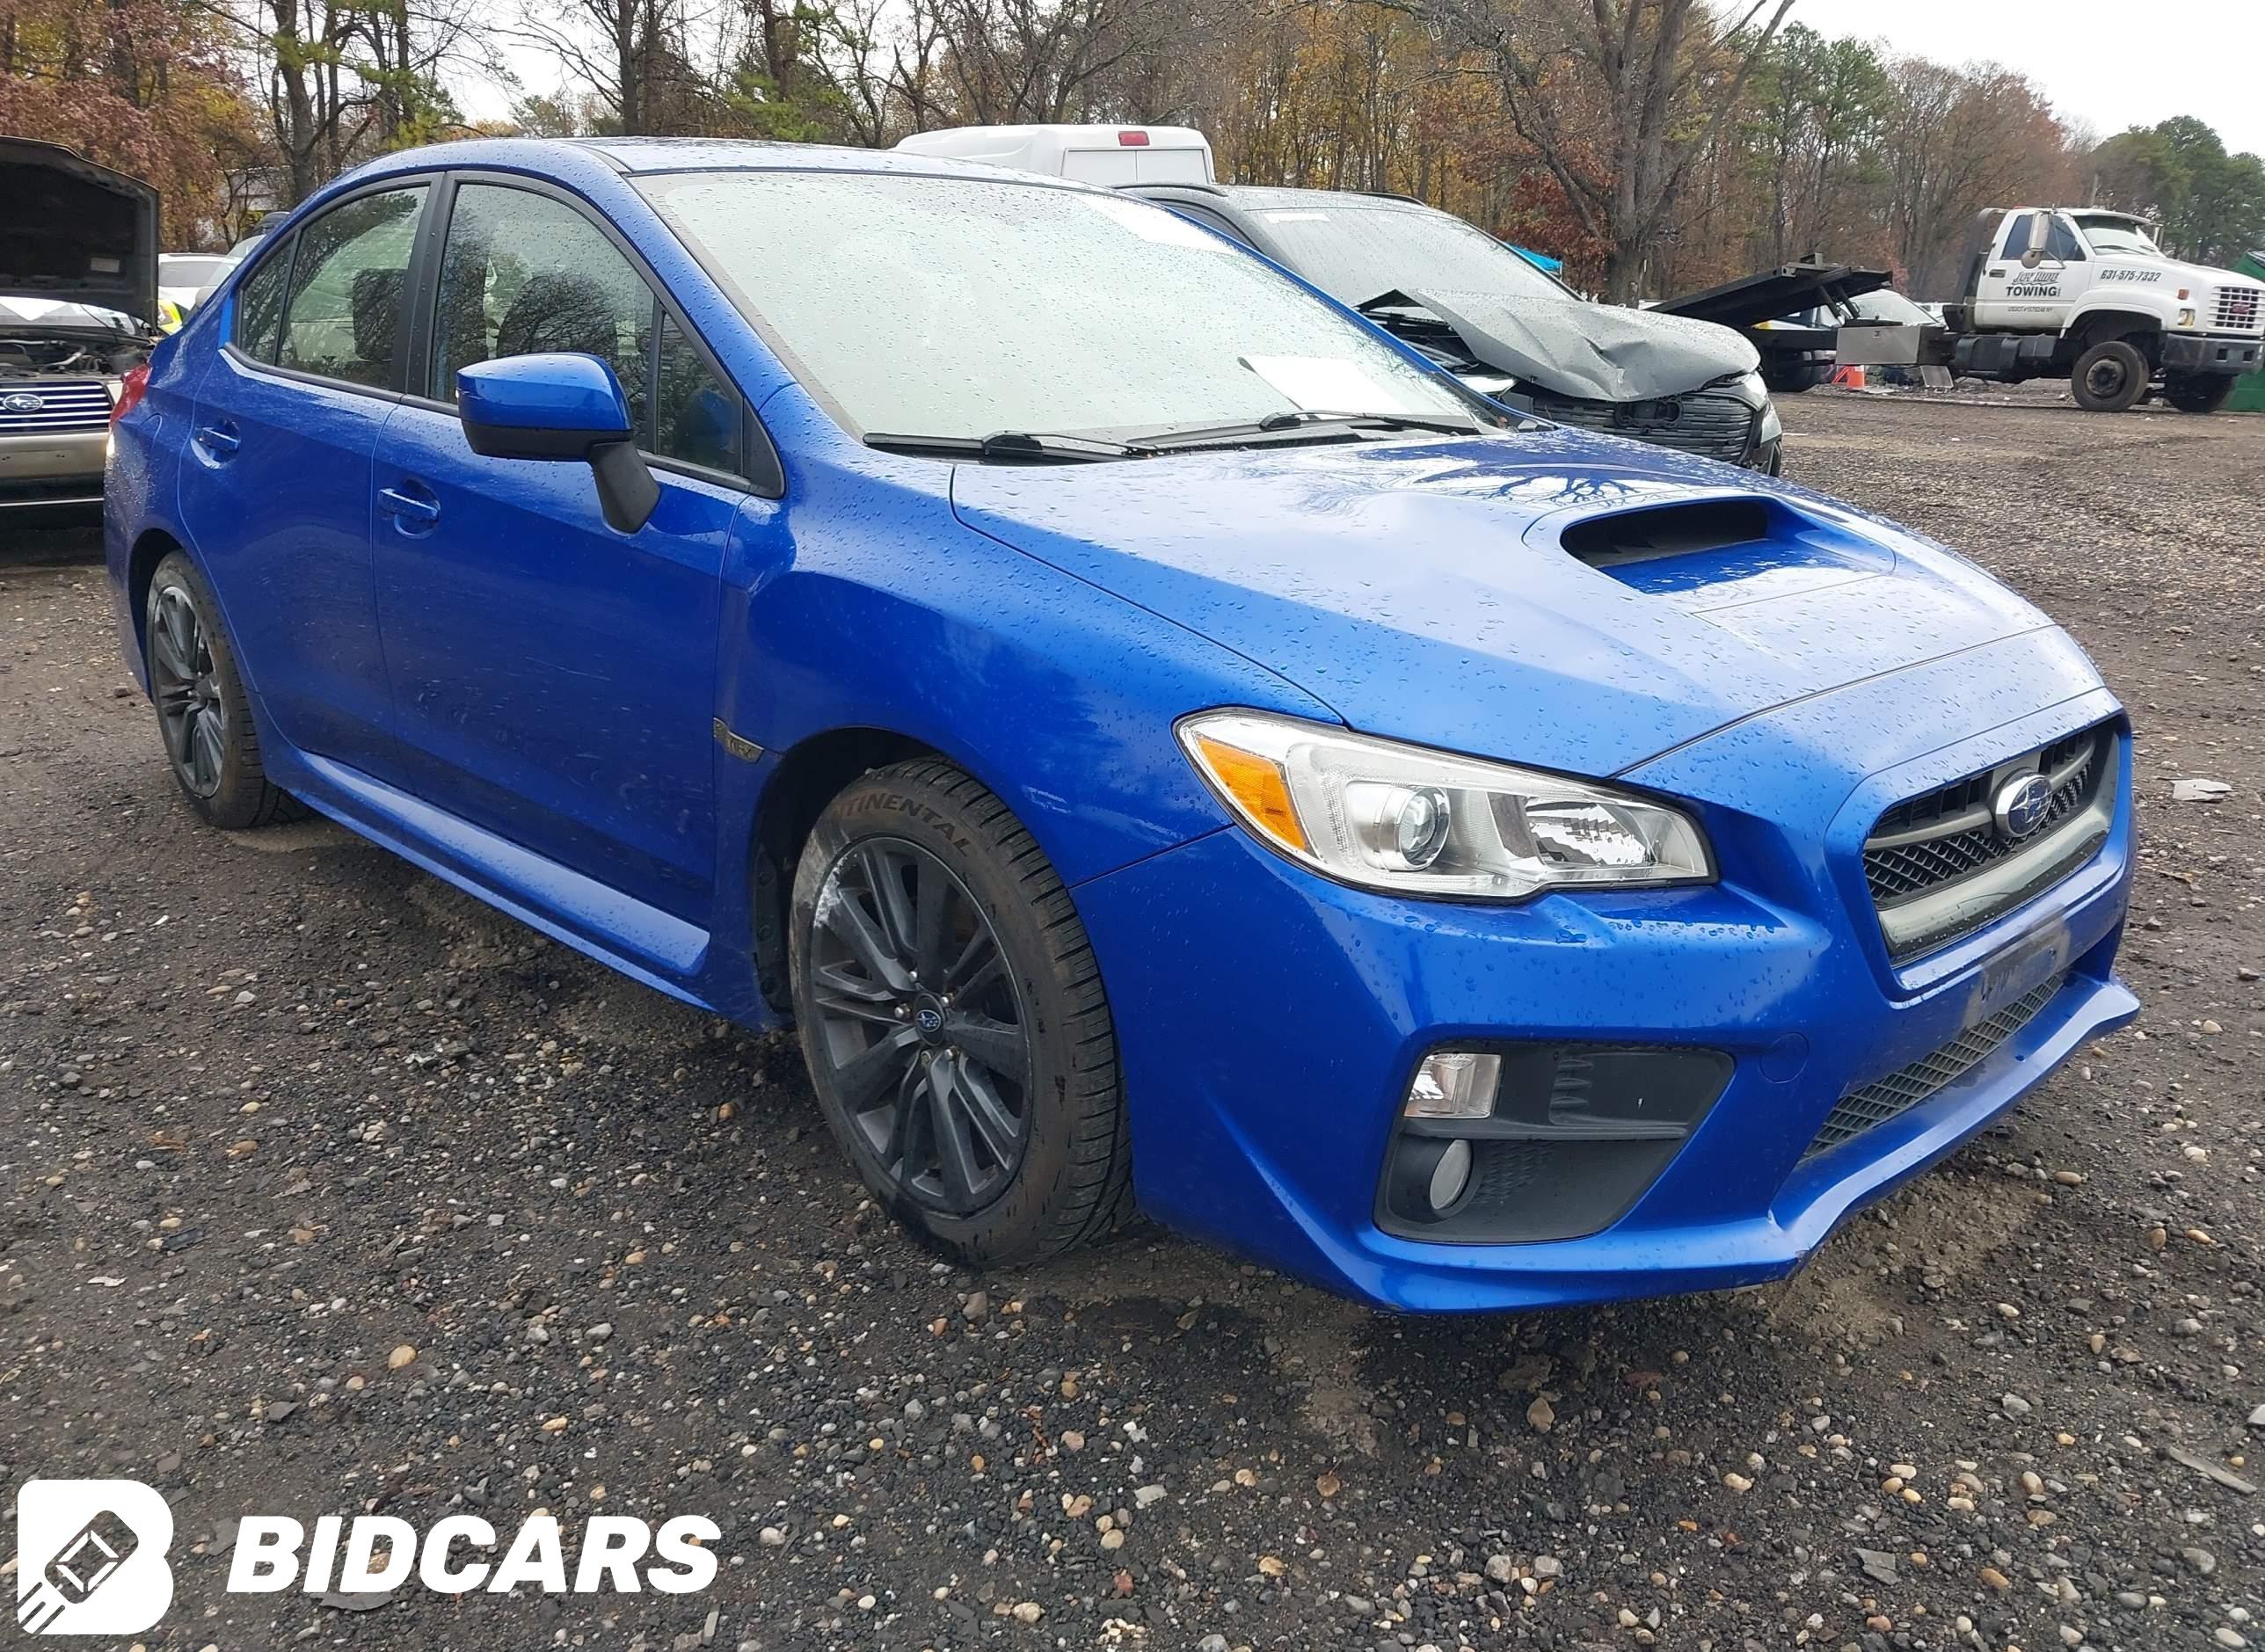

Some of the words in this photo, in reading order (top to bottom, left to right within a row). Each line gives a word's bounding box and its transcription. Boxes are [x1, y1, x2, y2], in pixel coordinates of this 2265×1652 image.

[2100, 269, 2162, 282] 631-575-7332
[2006, 286, 2057, 296] TOWING
[831, 793, 970, 857] NTINENTAL
